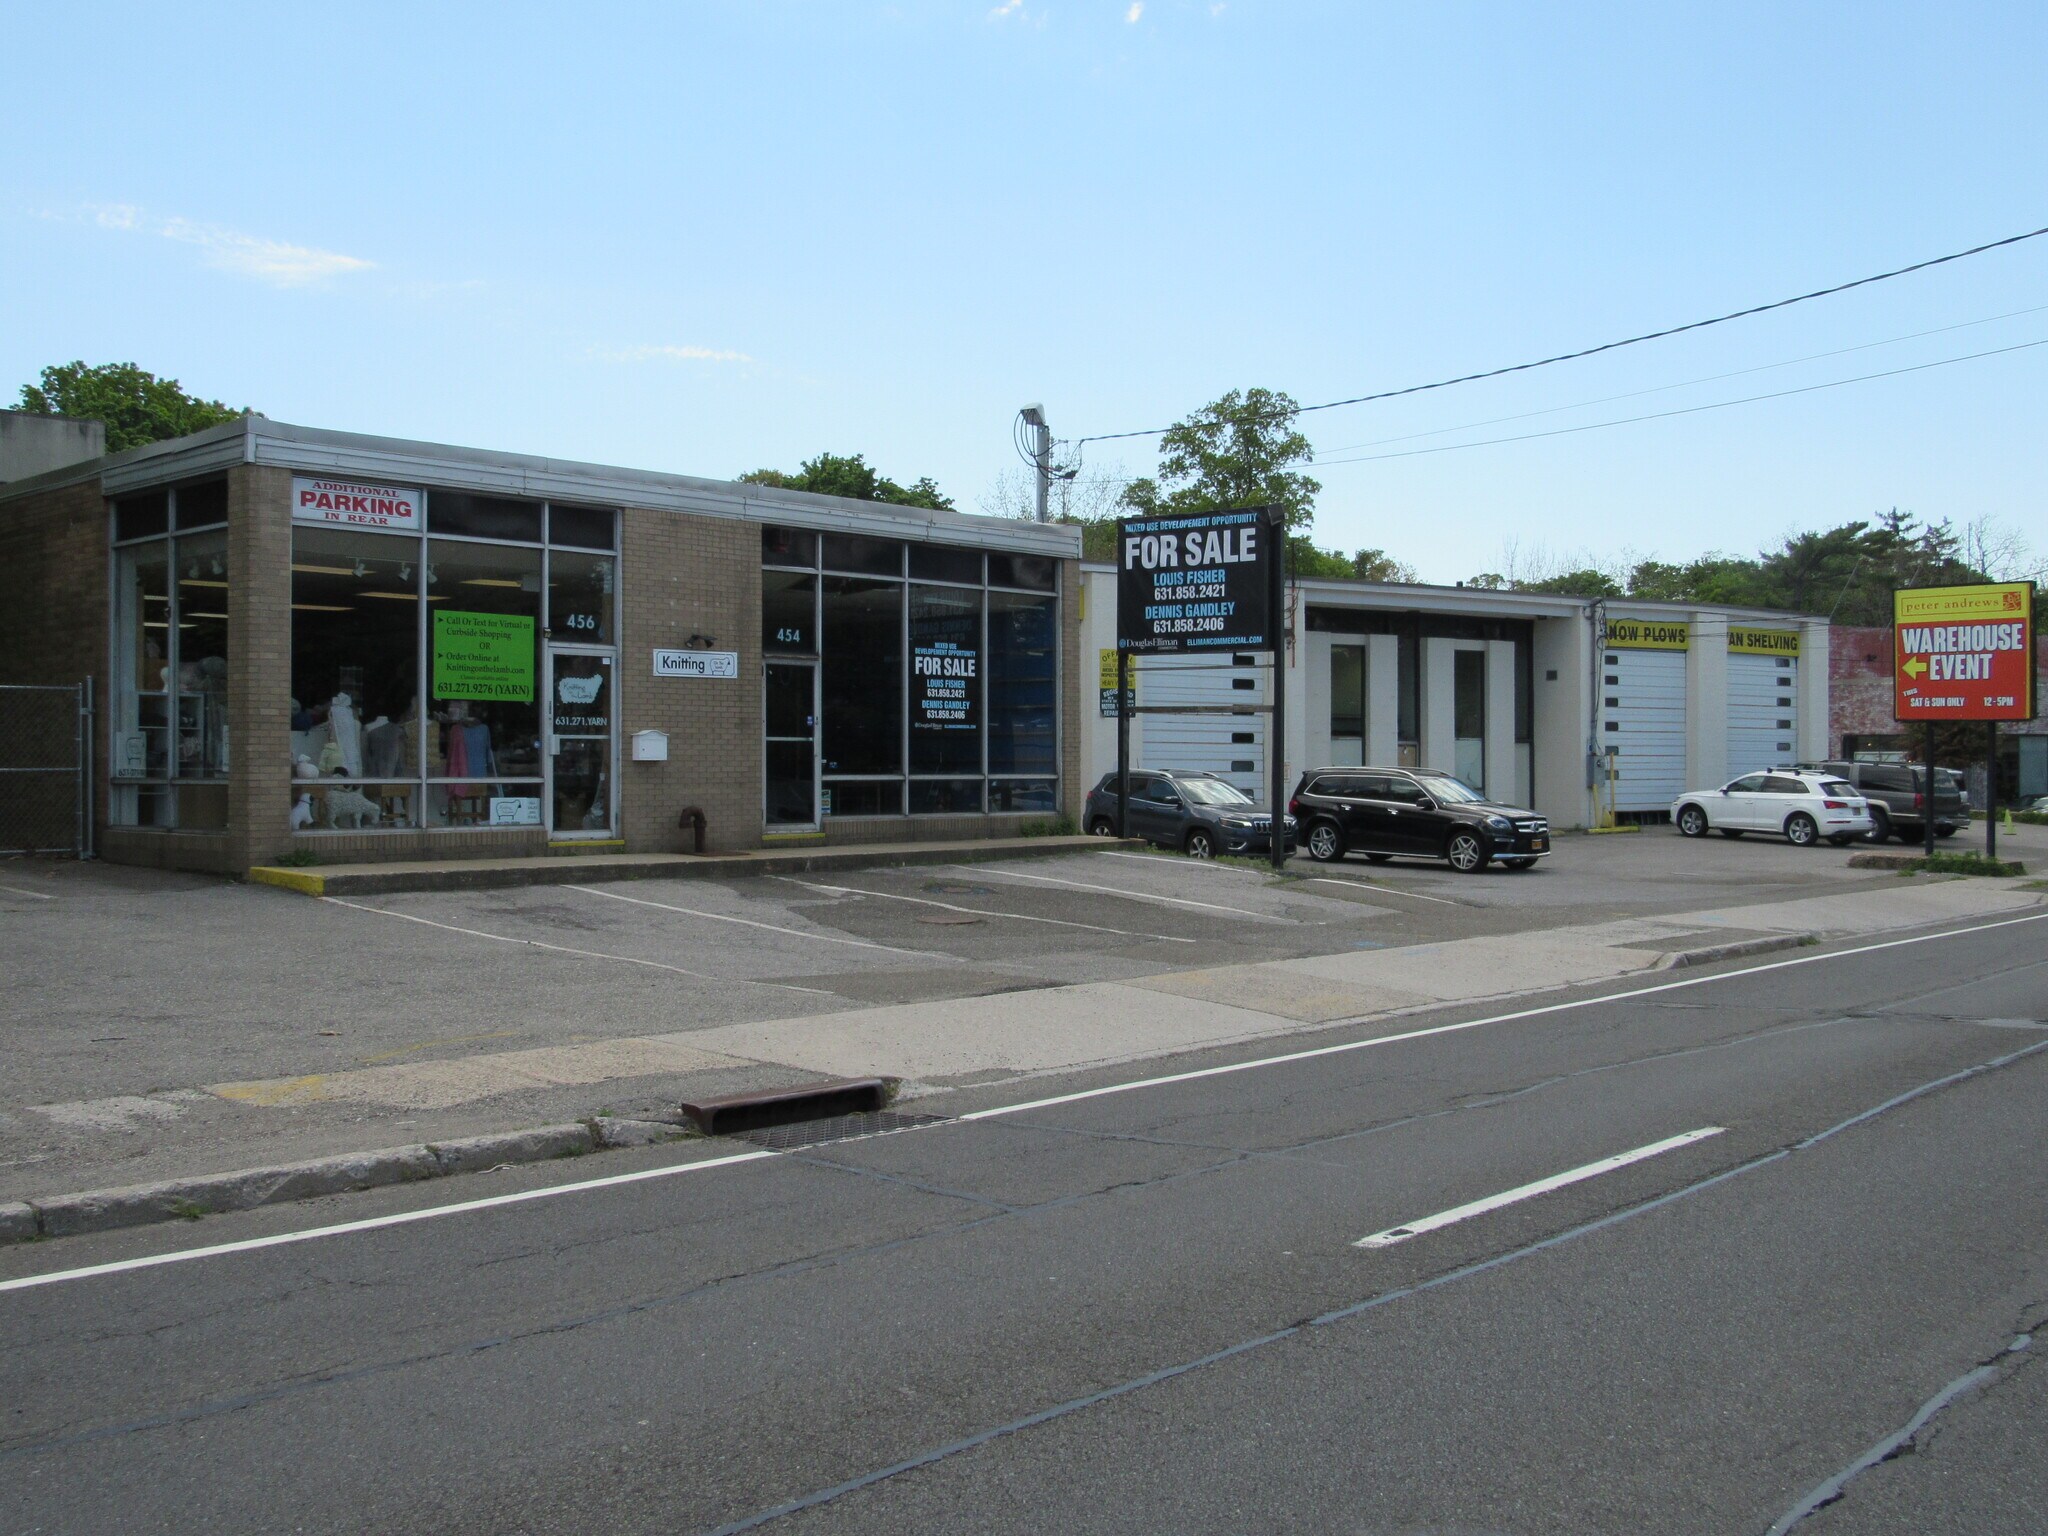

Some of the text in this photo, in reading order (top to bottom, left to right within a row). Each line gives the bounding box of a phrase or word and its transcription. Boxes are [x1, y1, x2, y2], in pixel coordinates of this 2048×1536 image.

[312, 482, 400, 498] ADDITIONAL
[301, 491, 411, 517] PARKING
[325, 512, 388, 525] IN REAR
[1125, 513, 1258, 532] MIXED USE DEVELOPEMENT OPPORTUNITY
[1125, 528, 1256, 570] FOR SALE
[1154, 569, 1225, 586] LOUIS FISHER
[1154, 584, 1225, 600] 631.858.2421
[1145, 602, 1235, 619] DENNIS GANDLEY
[1906, 598, 1999, 612] peter andrews
[446, 616, 461, 625] Call
[462, 617, 472, 625] Or
[473, 618, 487, 627] Text
[488, 619, 497, 627] for
[500, 620, 522, 629] Virtual
[567, 614, 595, 629] 456
[1153, 618, 1225, 633] 631.858.2406
[446, 628, 512, 640] Curbside Shopping
[777, 628, 800, 642] 454
[1605, 626, 1685, 643] NOW PLOWS
[1747, 633, 1797, 650] SHELVING
[1902, 623, 2023, 654] WAREHOUSE
[479, 642, 491, 650] OR
[1126, 636, 1262, 649] DouglasElliman ELLIMANCOMMERCIAL.COM
[446, 652, 466, 660] Order
[468, 653, 491, 662] Online
[662, 656, 705, 673] Knitting
[915, 656, 976, 677] FOR SALE
[1930, 653, 1993, 680] EVENT
[438, 682, 530, 697] 631.271.9276 (YARN)
[927, 679, 965, 688] LOUIS FISHER
[927, 688, 965, 698] 631.858.2421
[1903, 688, 1918, 696] THIS
[922, 700, 970, 710] DENNIS GANDLEY
[1910, 697, 1965, 707] SAT & SUN ONLY
[555, 717, 607, 726] 631.271.YARN
[927, 710, 965, 719] 631.858.2406
